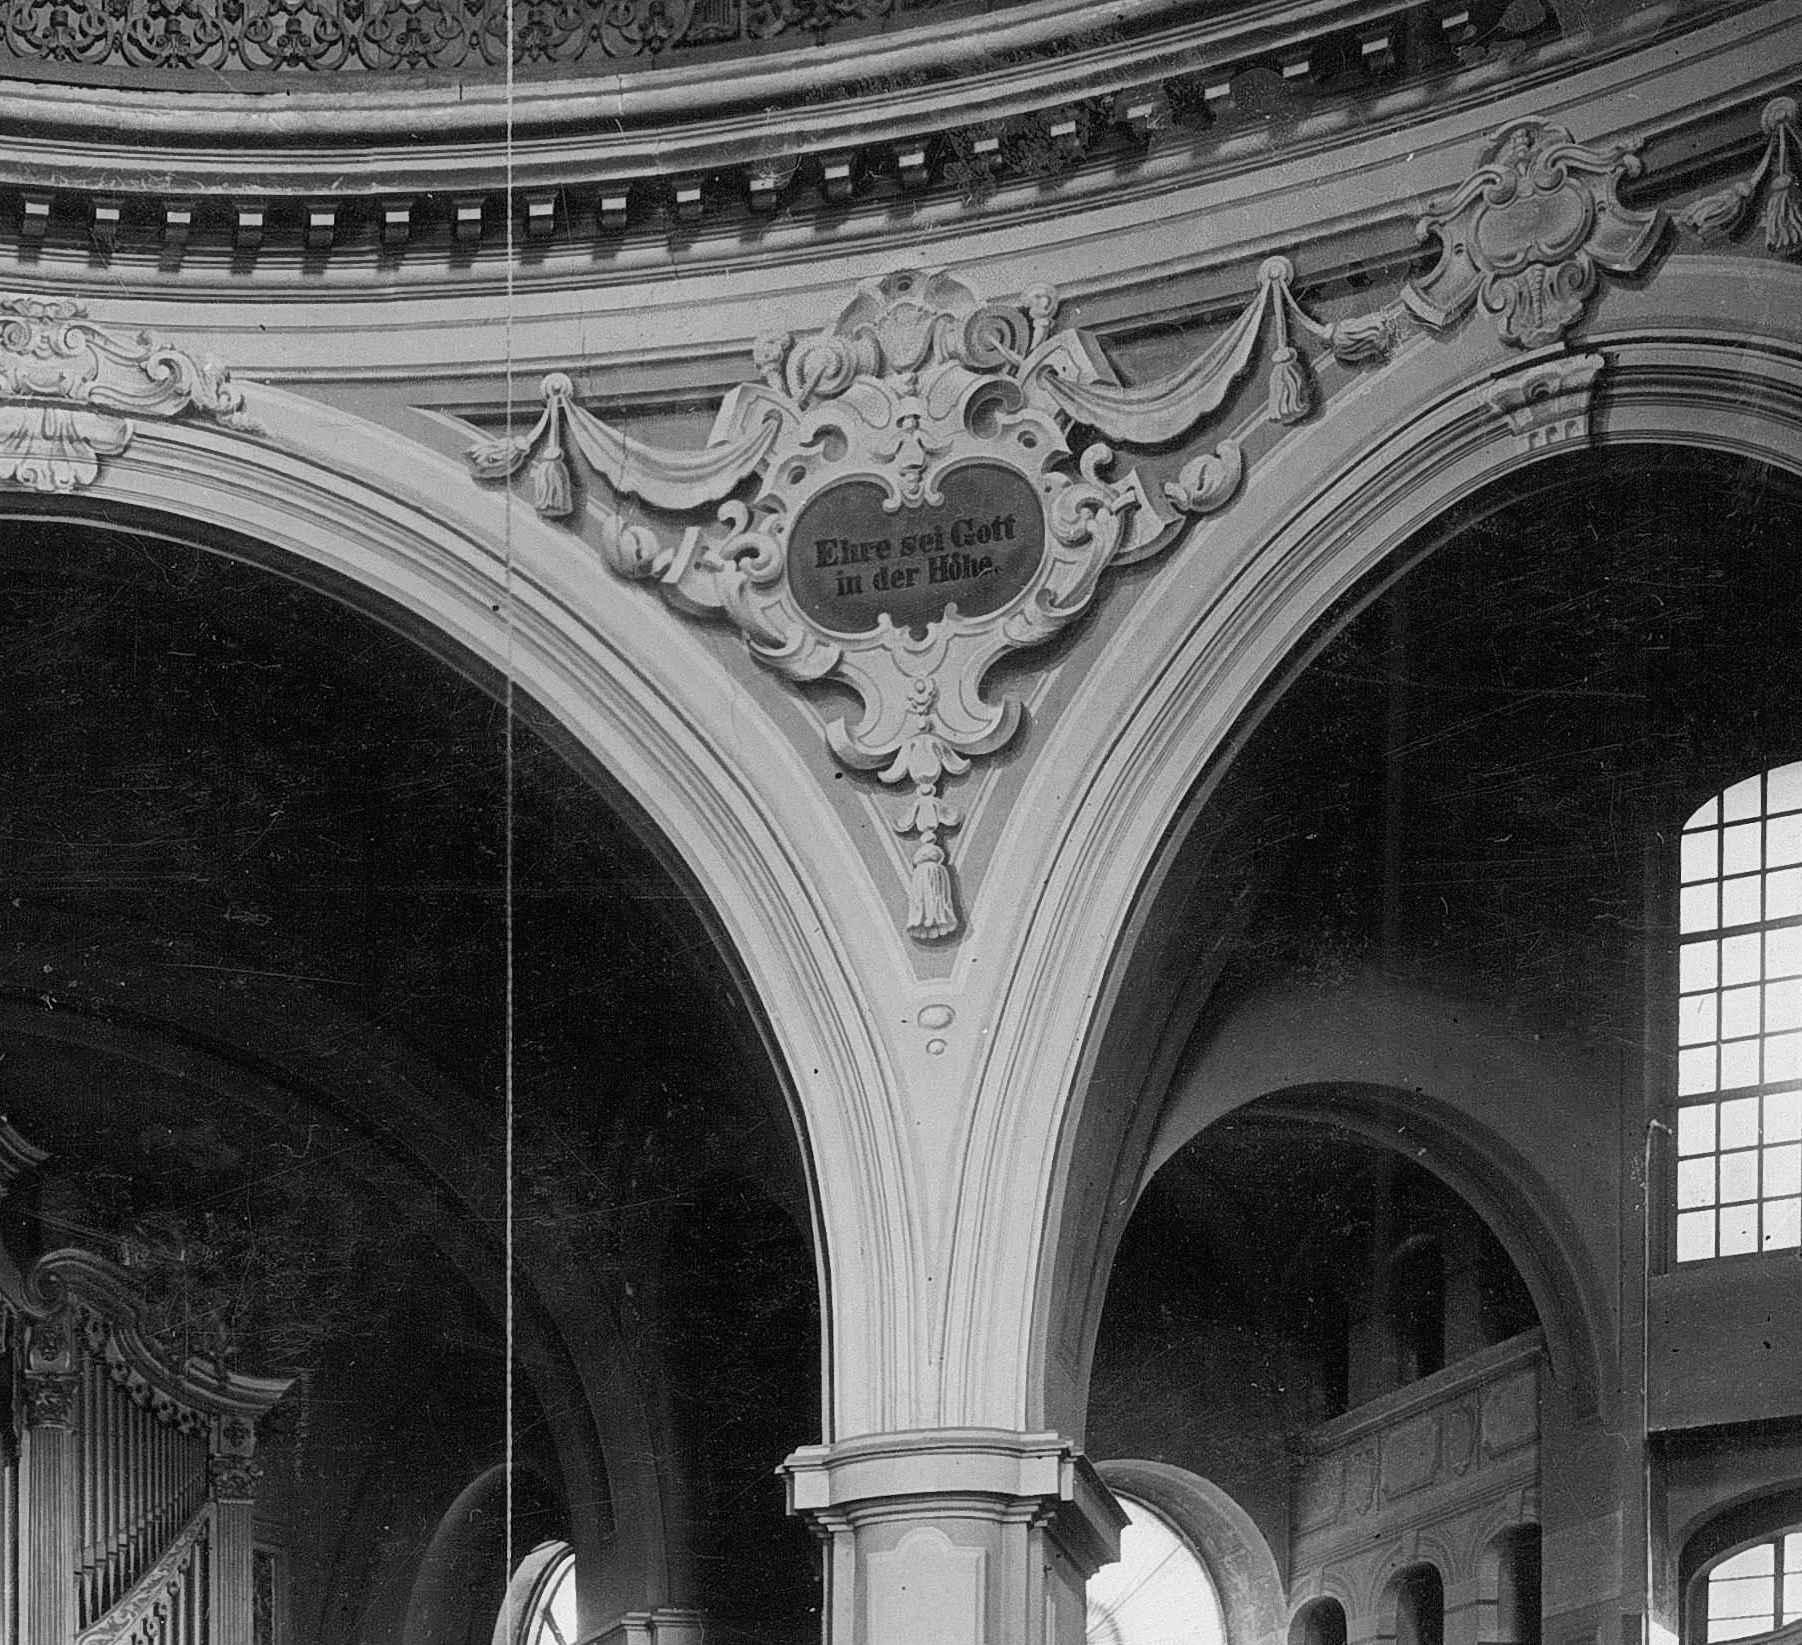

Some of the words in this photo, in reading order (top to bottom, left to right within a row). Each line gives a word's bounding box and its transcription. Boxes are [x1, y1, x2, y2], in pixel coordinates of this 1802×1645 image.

[814, 538, 891, 568] Ehre
[900, 525, 945, 558] sei
[950, 514, 1016, 547] Gott
[836, 572, 862, 596] in
[872, 565, 920, 592] der
